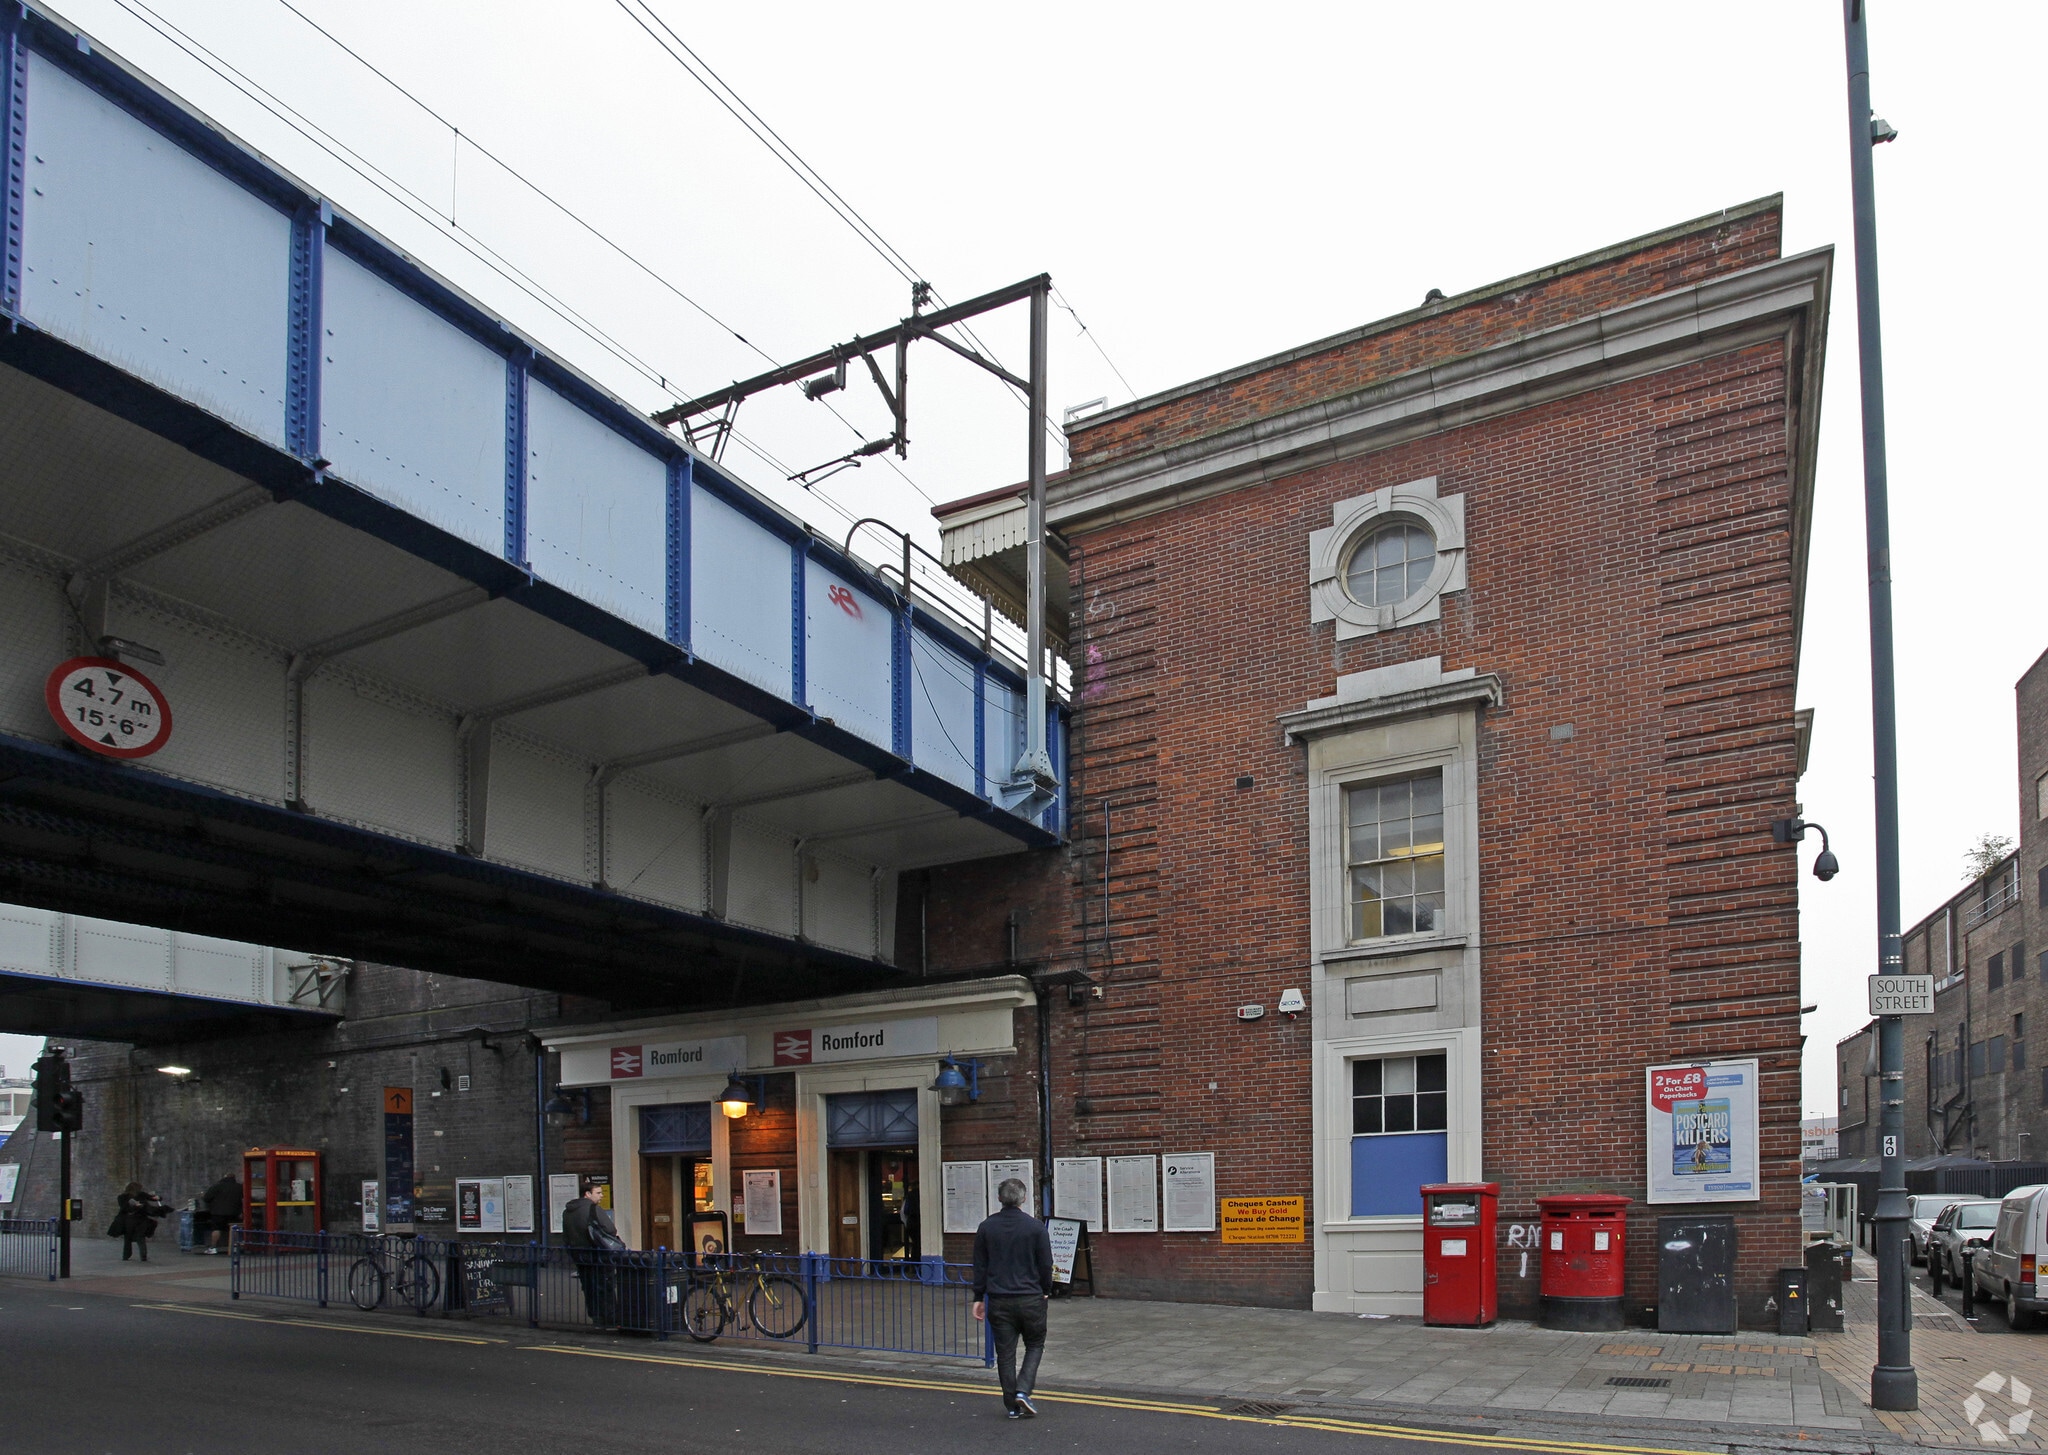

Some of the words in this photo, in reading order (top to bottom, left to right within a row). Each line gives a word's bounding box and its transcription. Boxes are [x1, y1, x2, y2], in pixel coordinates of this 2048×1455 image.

[73, 677, 124, 706] 4.7
[130, 699, 152, 716] m
[1876, 979, 1927, 994] SOUTH
[1875, 994, 1929, 1010] STREET
[821, 1029, 885, 1051] Romford
[650, 1046, 703, 1066] Romford
[1655, 1075, 1664, 1087] 2
[1665, 1077, 1682, 1086] For
[1682, 1073, 1702, 1085] £8
[1659, 1092, 1698, 1100] Paperbacks
[1676, 1112, 1728, 1130] POSTCARD
[1676, 1128, 1729, 1146] KILLERS
[1227, 1201, 1264, 1209] Cheques
[1266, 1199, 1297, 1207] Cashed
[1251, 1208, 1267, 1216] Buy
[1256, 1215, 1266, 1223] de
[1268, 1215, 1301, 1224] Change
